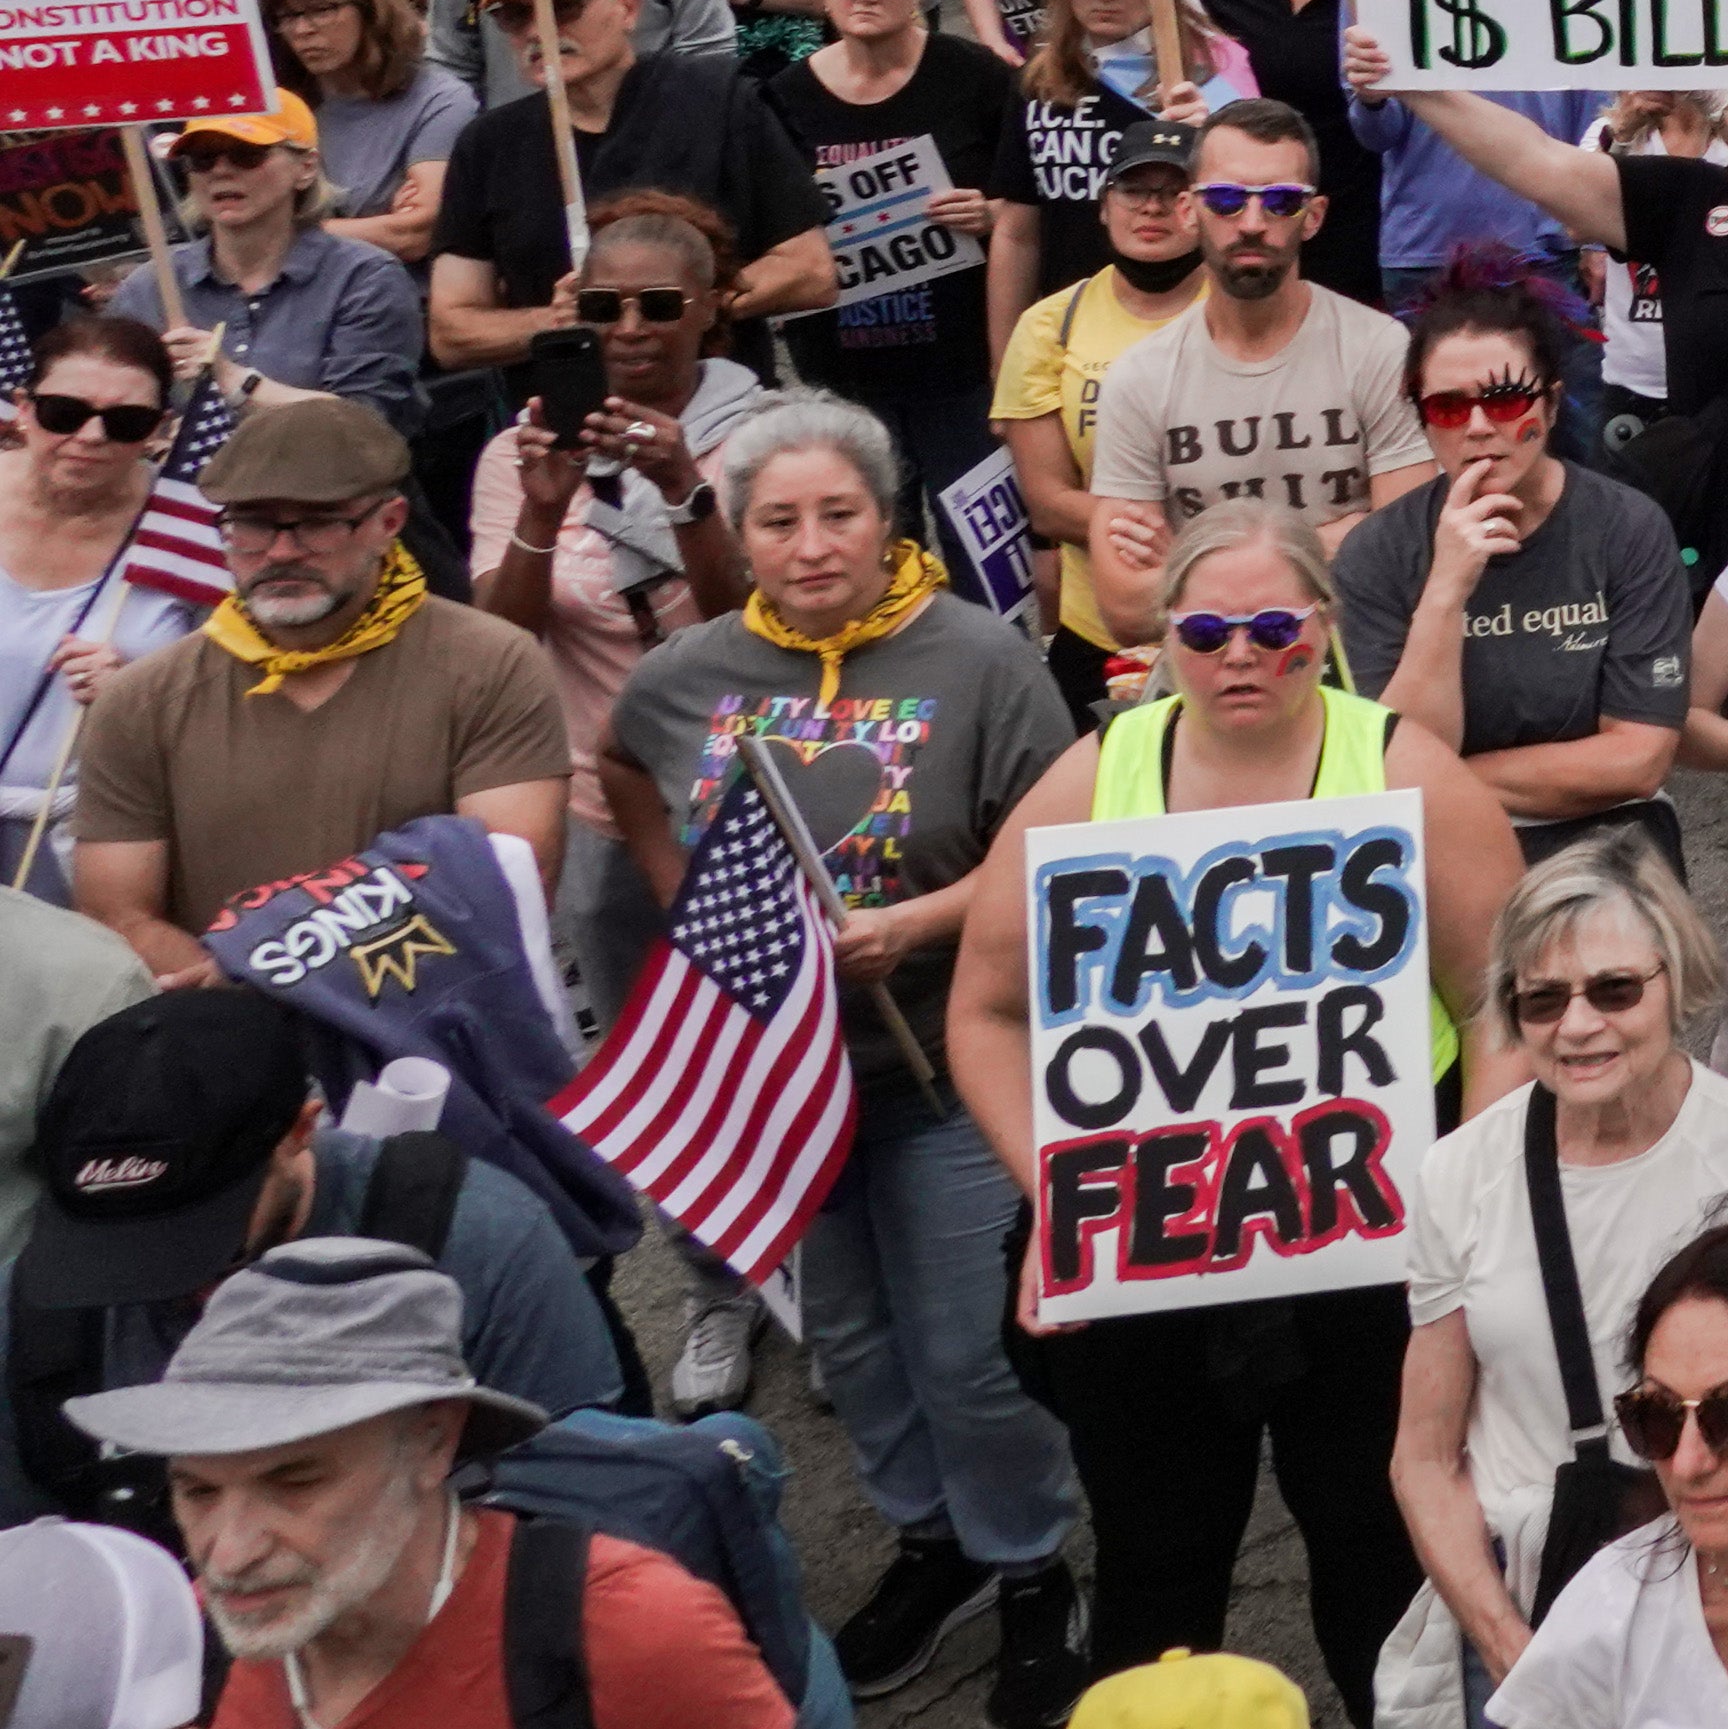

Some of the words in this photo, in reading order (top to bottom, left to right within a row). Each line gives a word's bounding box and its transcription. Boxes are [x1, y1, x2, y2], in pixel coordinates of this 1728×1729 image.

[0, 40, 83, 71] NOT
[127, 30, 230, 62] KING
[850, 153, 920, 200] OFF
[1167, 408, 1361, 468] BULL
[1523, 593, 1609, 636] equal
[1040, 828, 1420, 1024] FACTS
[1045, 985, 1398, 1131] OVER
[1042, 1100, 1407, 1296] FEAR
